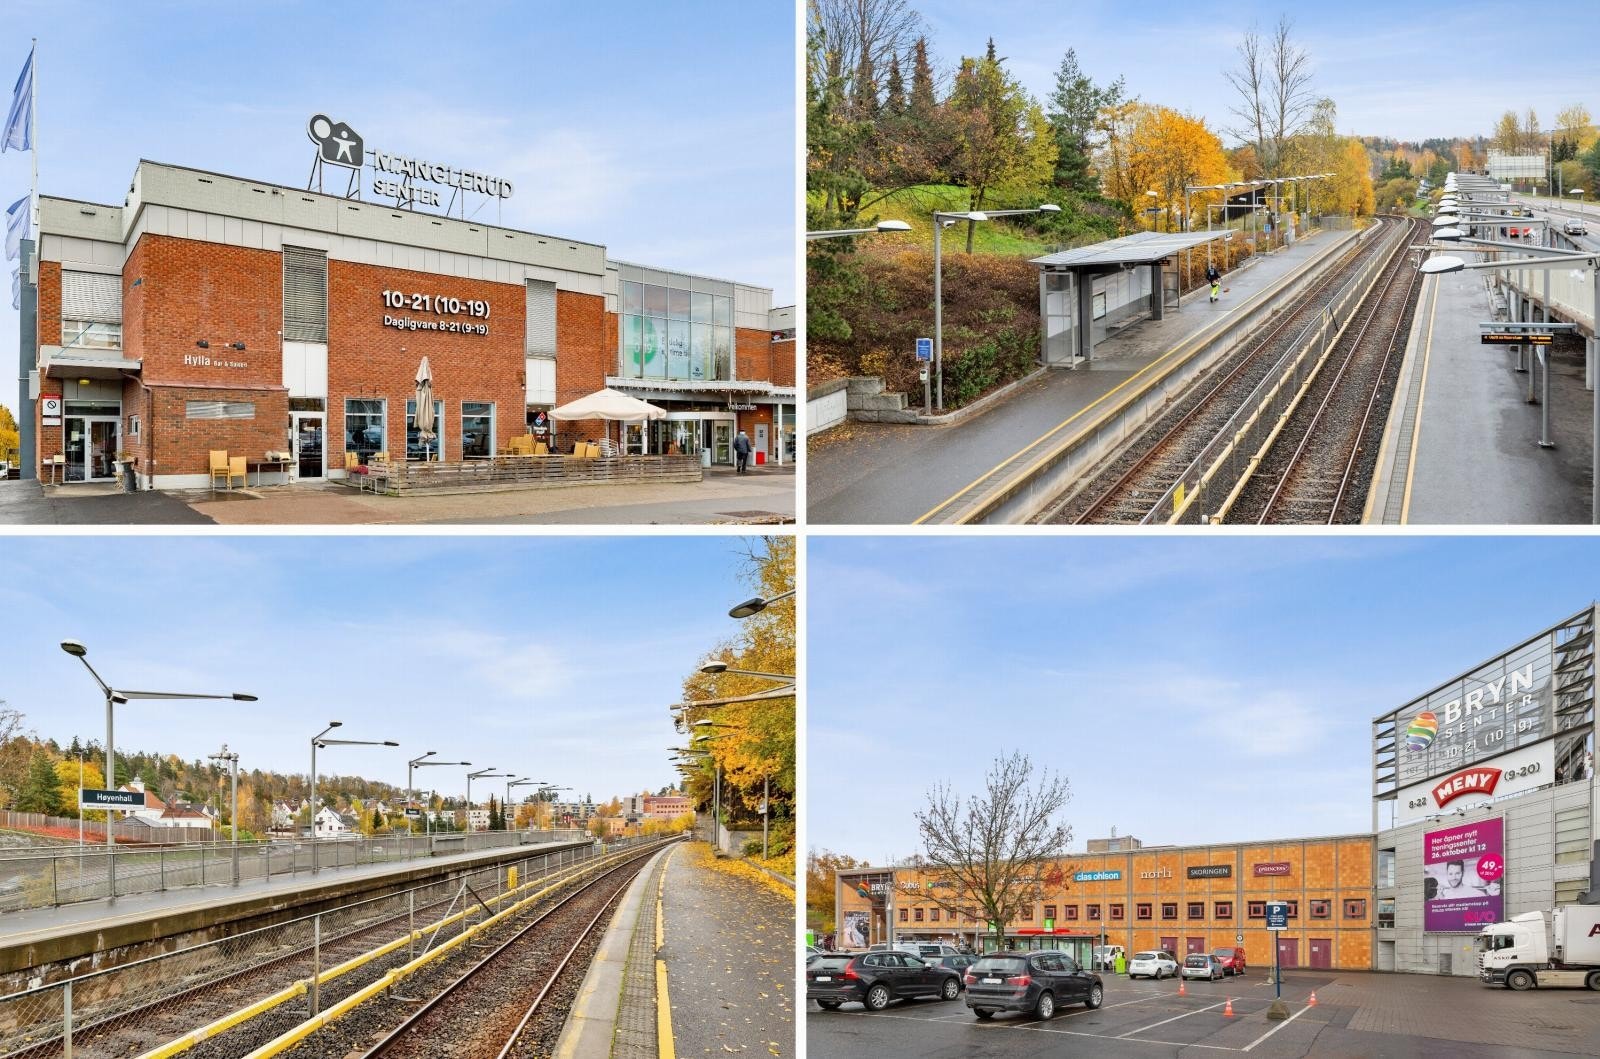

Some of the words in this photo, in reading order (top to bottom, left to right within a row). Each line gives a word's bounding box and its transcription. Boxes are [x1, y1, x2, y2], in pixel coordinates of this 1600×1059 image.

[374, 149, 514, 198] MANGLERUD
[374, 178, 440, 206] SENTER
[382, 290, 430, 311] 10-21
[434, 295, 490, 319] (10-19)
[384, 315, 437, 330] Dagligvare
[439, 320, 459, 332] 8-21
[461, 323, 489, 335] (9-19)
[184, 354, 210, 366] Hylla
[1444, 663, 1533, 725] BRYN
[1445, 693, 1532, 738] SENTER
[1447, 739, 1477, 759] 10-21
[1485, 718, 1532, 746] (10-19)
[1504, 761, 1541, 781] (9-20)
[1437, 773, 1492, 800] MENY
[96, 793, 132, 802] Høyenhall
[1409, 797, 1427, 809] 8-22
[1443, 834, 1463, 844] åpner
[1464, 830, 1478, 840] nytt
[1431, 838, 1477, 852] treningssenter
[1442, 848, 1467, 857] oktober
[1477, 843, 1486, 851] 12
[1141, 866, 1172, 878] norli
[1481, 860, 1502, 872] 49,-
[1093, 872, 1119, 880] ohlson
[1273, 906, 1280, 914] P
